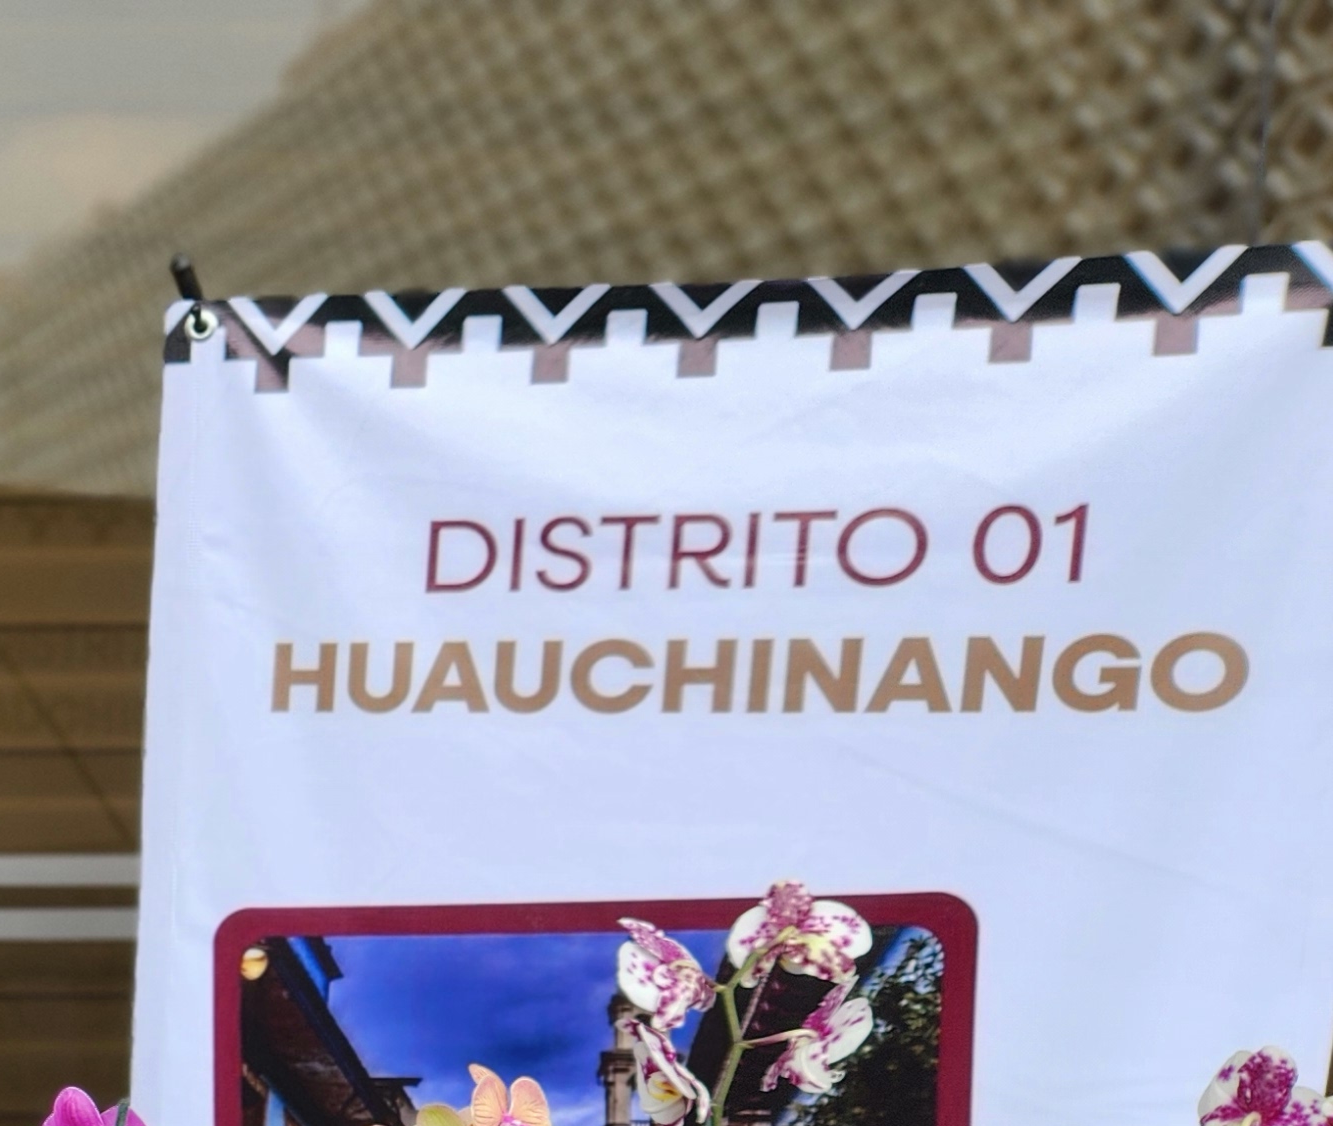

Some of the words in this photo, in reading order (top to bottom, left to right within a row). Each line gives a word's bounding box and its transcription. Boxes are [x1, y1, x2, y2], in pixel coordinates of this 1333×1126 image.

[425, 507, 928, 594] DISTRITO
[970, 502, 1090, 585] 01
[271, 630, 1250, 714] HUAUCHINANGO
